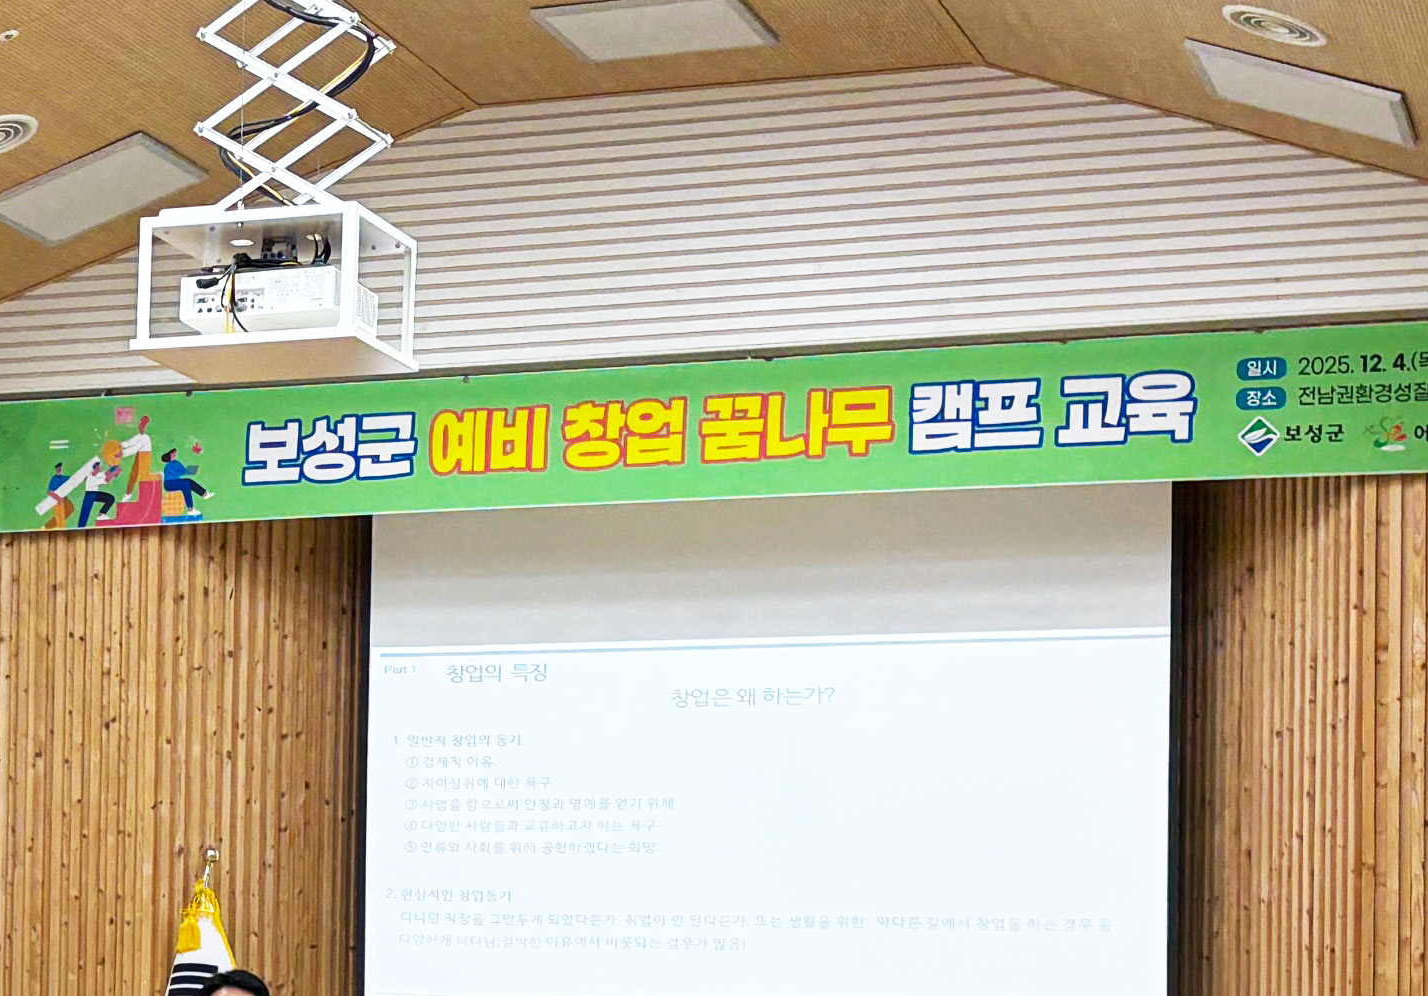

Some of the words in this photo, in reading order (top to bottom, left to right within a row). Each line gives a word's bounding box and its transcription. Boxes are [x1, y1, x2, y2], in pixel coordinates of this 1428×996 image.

[1247, 360, 1277, 376] 일시
[1298, 355, 1354, 375] 2025.
[1360, 354, 1387, 373] 12.
[1247, 390, 1277, 406] 장소
[241, 411, 417, 486] 보성군
[429, 404, 550, 476] 예비
[563, 397, 688, 470] 창업
[700, 385, 895, 463] 꿈나무
[909, 377, 1043, 455] 캠프
[1054, 370, 1197, 449] 교육
[1284, 424, 1344, 443] 보성군
[384, 665, 407, 675] Part
[446, 664, 502, 684] 창업의
[510, 663, 548, 683] 특징
[670, 687, 733, 709] 창업은
[736, 687, 756, 706] 왜
[762, 686, 836, 706] 하는가?
[393, 735, 405, 745] 1.
[406, 734, 446, 748] 일반적
[451, 734, 491, 748] 창업의
[496, 733, 521, 747] 동기
[423, 756, 462, 769] 경제적
[494, 776, 520, 790] 대한
[525, 776, 553, 790] 욕구
[421, 798, 463, 812] 사업을
[465, 798, 519, 812] 함으로써
[524, 798, 565, 812] 인정과
[646, 797, 674, 811] 위해
[421, 819, 462, 833] 다양한
[465, 819, 519, 834] 사람들과
[524, 819, 594, 833] 교류하고자
[596, 819, 626, 833] 하는
[629, 819, 657, 833] 욕구
[420, 840, 461, 854] 인류와
[464, 841, 506, 855] 사회를
[509, 841, 536, 855] 위해
[627, 840, 656, 855] 희망
[400, 911, 440, 925] 다니던
[444, 912, 485, 927] 직장을
[489, 913, 543, 927] 그만두게
[624, 913, 666, 928] 취업이
[671, 914, 684, 928] 안
[835, 915, 866, 929] 위한
